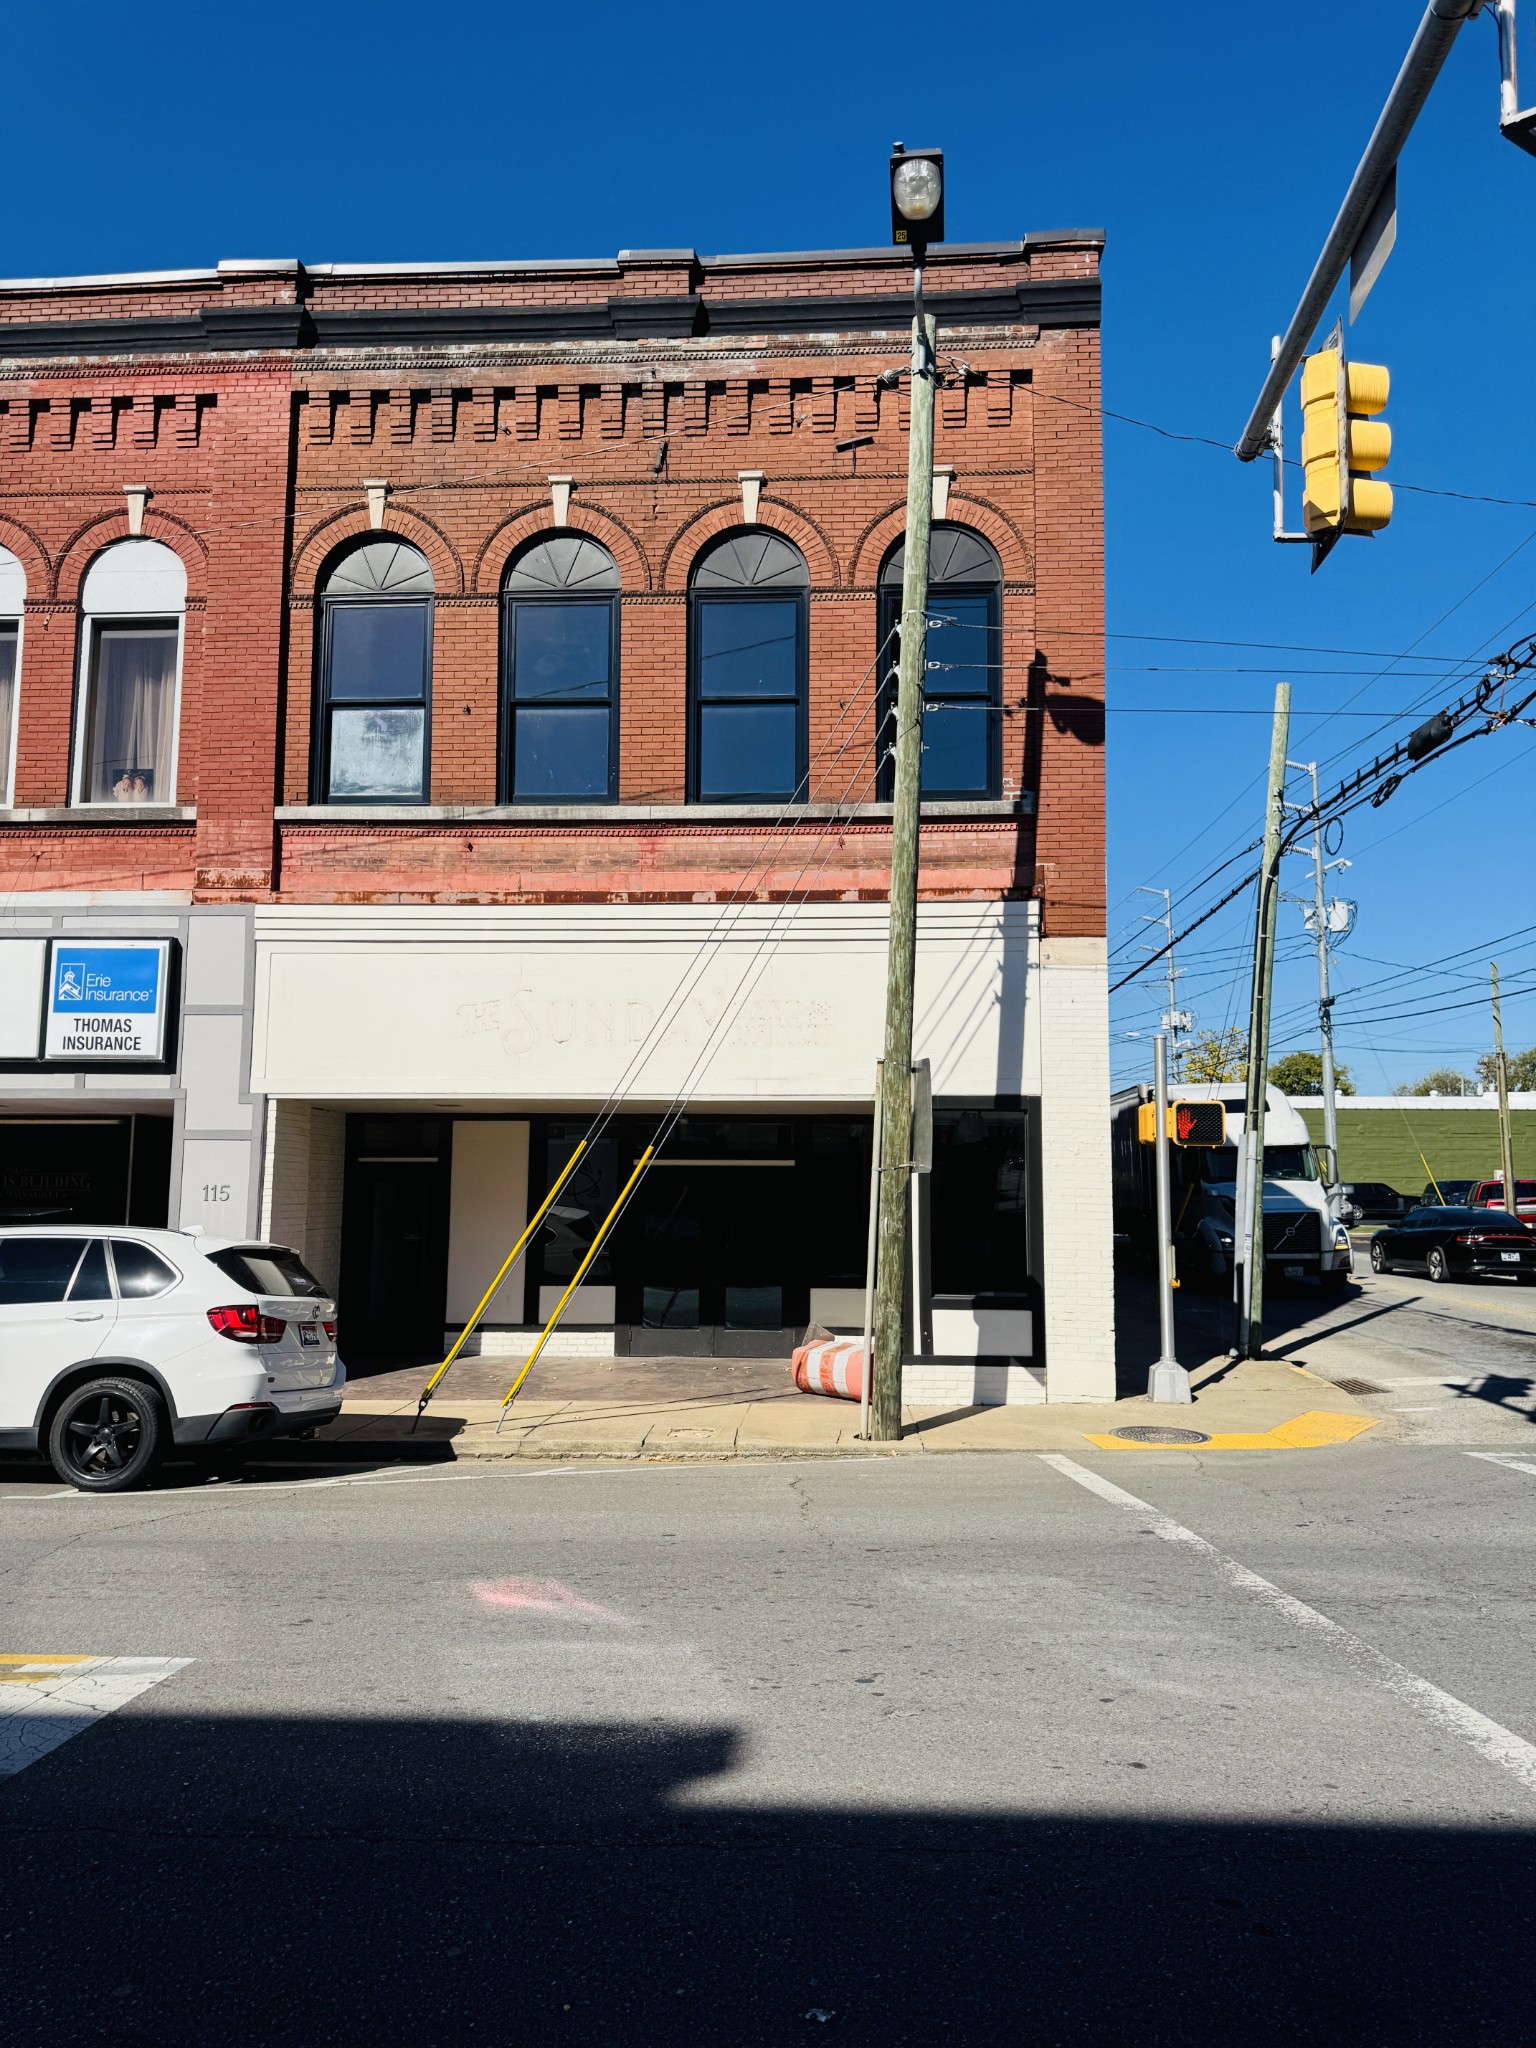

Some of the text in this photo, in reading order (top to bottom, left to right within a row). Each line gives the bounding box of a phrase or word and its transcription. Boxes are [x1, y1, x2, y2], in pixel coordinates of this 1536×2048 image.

[897, 231, 905, 240] 25
[86, 973, 111, 987] Erie
[85, 987, 149, 1002] Insurance
[73, 1018, 132, 1033] THOMAS
[62, 1035, 142, 1051] INSURANCE
[20, 1175, 91, 1188] BUILDING
[202, 1184, 231, 1202] 115
